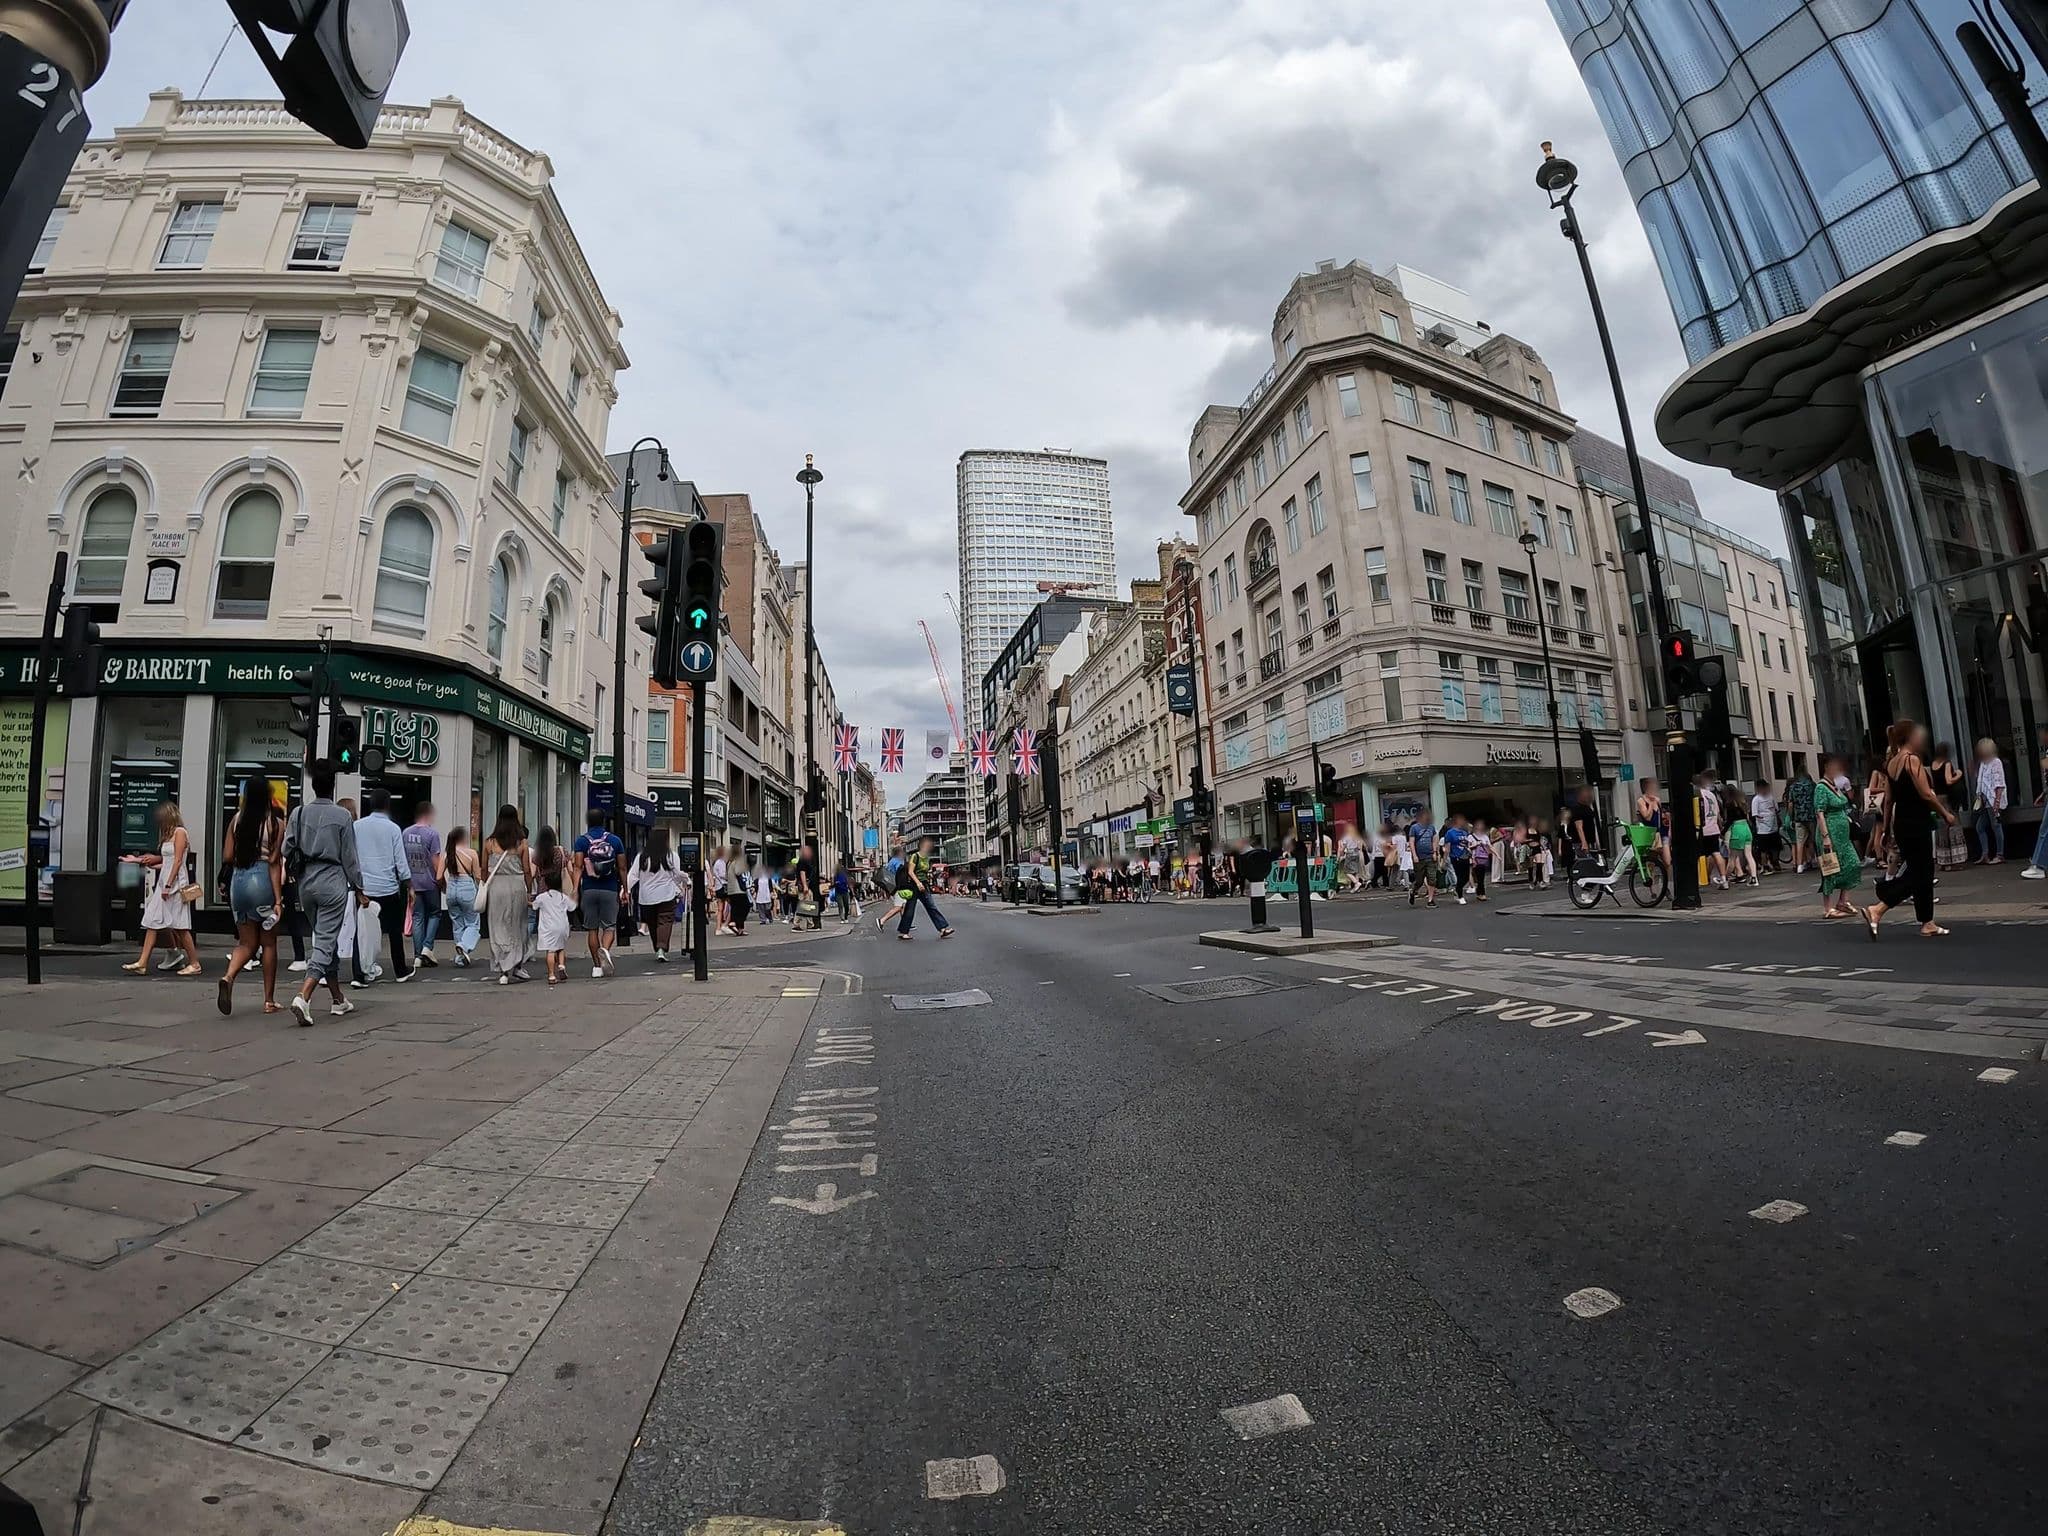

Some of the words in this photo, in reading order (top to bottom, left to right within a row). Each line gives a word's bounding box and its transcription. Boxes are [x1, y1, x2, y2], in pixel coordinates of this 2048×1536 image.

[151, 540, 169, 548] PLACE
[152, 533, 185, 541] RATHBONE
[104, 658, 123, 683] &
[125, 658, 211, 684] BARRETT
[228, 664, 272, 680] health
[350, 670, 381, 683] we're
[384, 675, 413, 689] good
[415, 678, 433, 694] for
[436, 684, 459, 699] you
[3, 709, 17, 719] We
[2, 723, 15, 731] our
[498, 699, 532, 730] HOLLAND
[532, 715, 540, 736] &
[539, 718, 568, 748] BARRETT
[1, 734, 10, 742] be
[0, 749, 24, 761] Why?
[1375, 744, 1423, 761] Accessorize
[1487, 742, 1544, 764] Accessorize
[0, 761, 14, 769] Ask
[635, 804, 646, 819] Shop
[1109, 815, 1132, 833] OFFICE
[1533, 950, 1665, 964] LOOK
[1705, 962, 1894, 977] LEFT
[1318, 973, 1475, 1004] LEFT
[1456, 998, 1642, 1037] LOOK
[804, 1026, 875, 1068] LOOK
[768, 1086, 880, 1177] RIGHT
